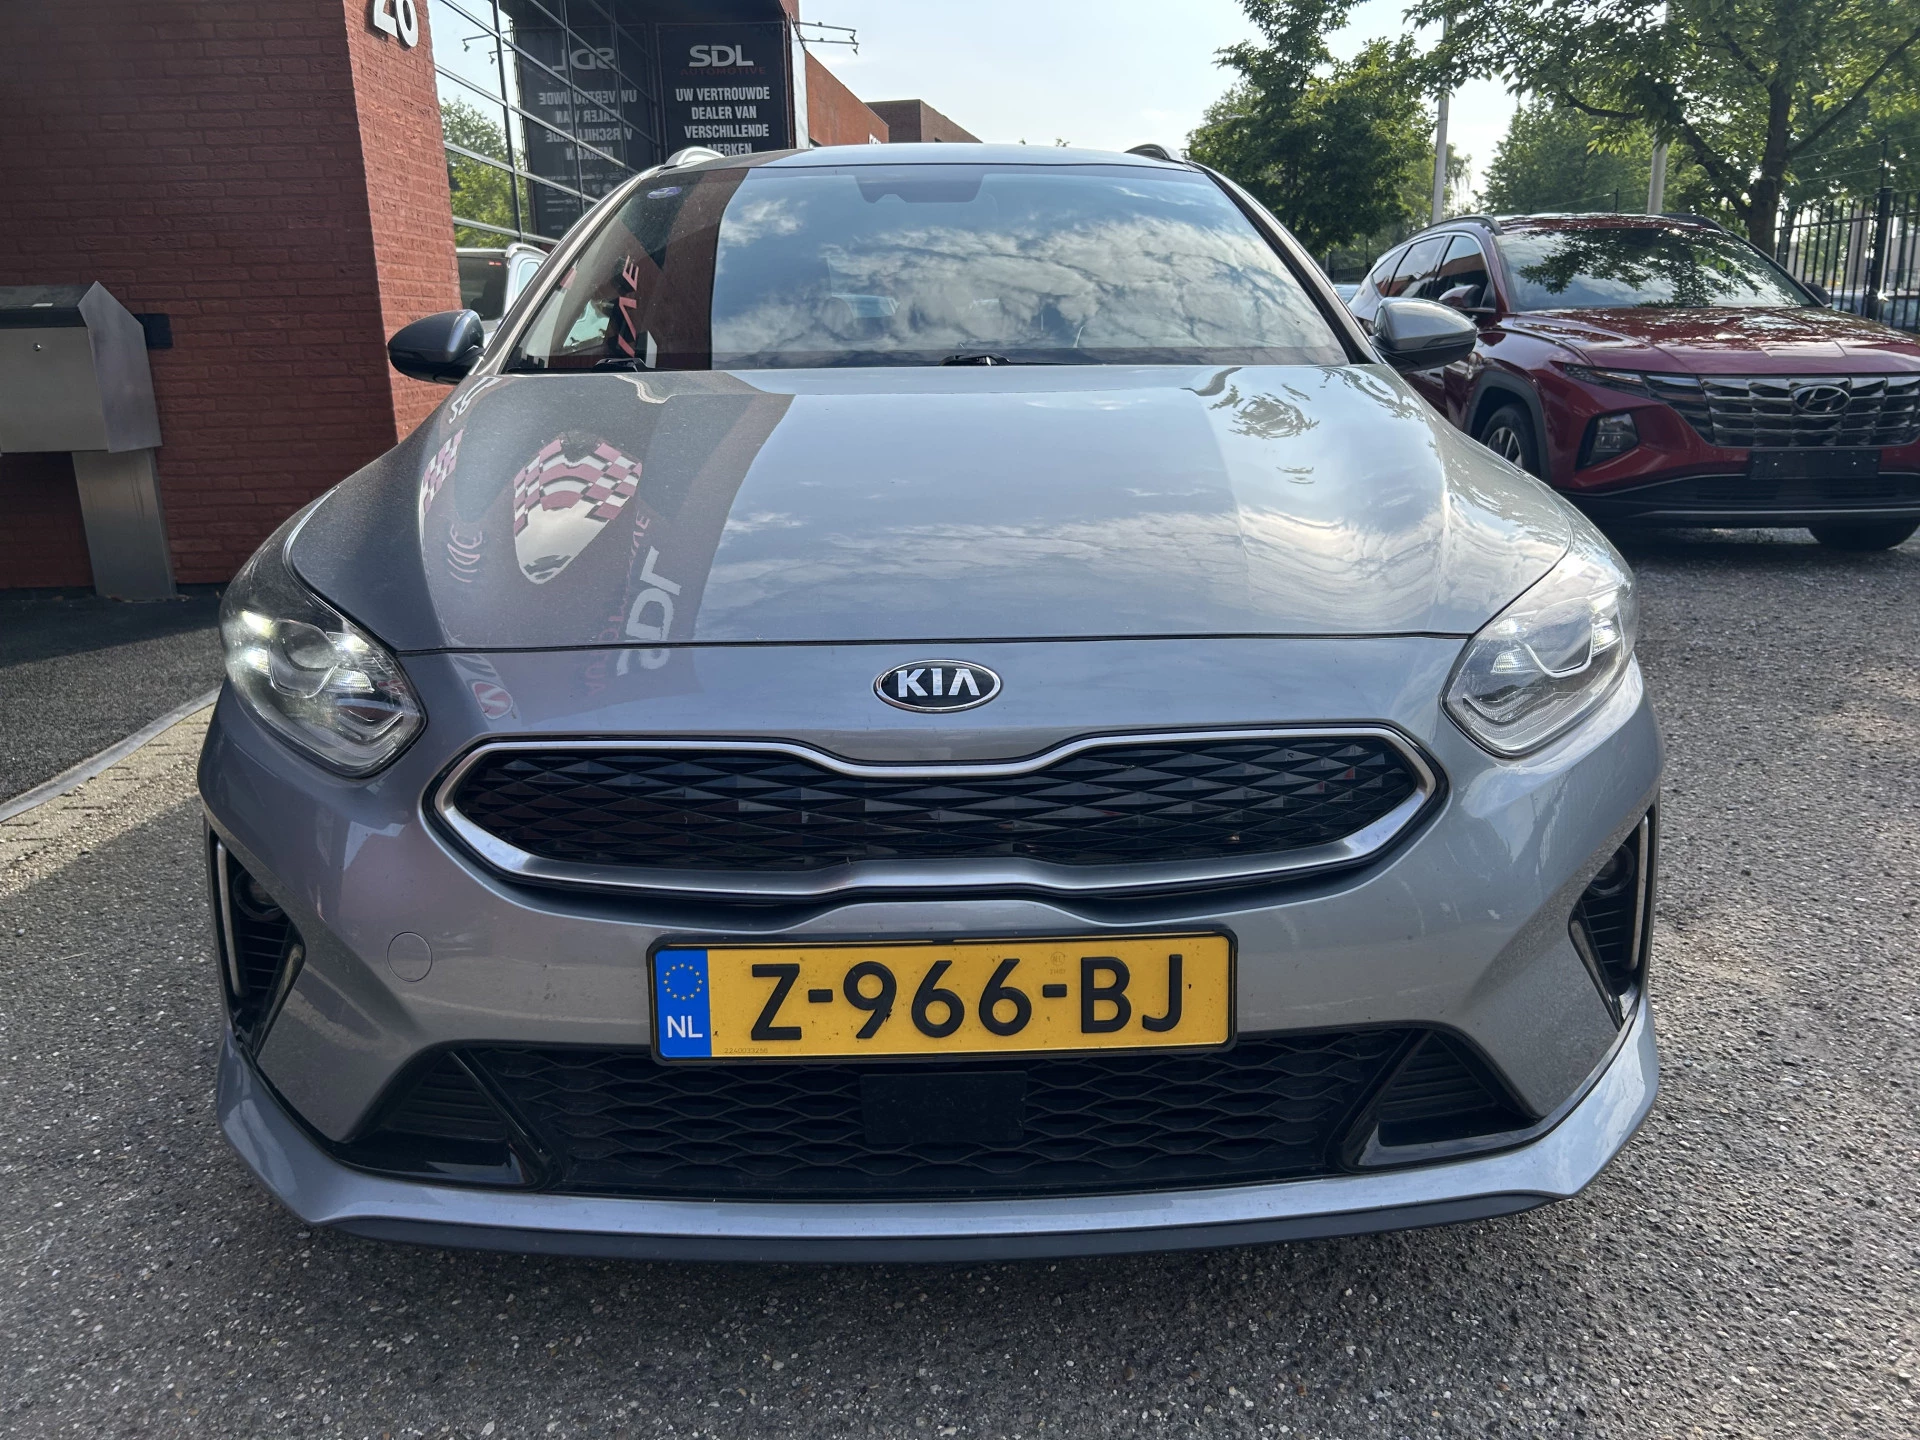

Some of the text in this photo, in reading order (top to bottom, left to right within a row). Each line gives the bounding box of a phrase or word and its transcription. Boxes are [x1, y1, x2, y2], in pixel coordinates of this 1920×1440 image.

[688, 44, 755, 67] SDL
[680, 66, 767, 77] AUTOMOTIVE
[675, 86, 771, 102] UW VERTROUWDE
[691, 105, 757, 120] DEALER VAN
[684, 123, 770, 139] VERSCHILLENDE
[896, 667, 981, 698] KIA
[667, 953, 1184, 1042] NL Z-966-BJ
